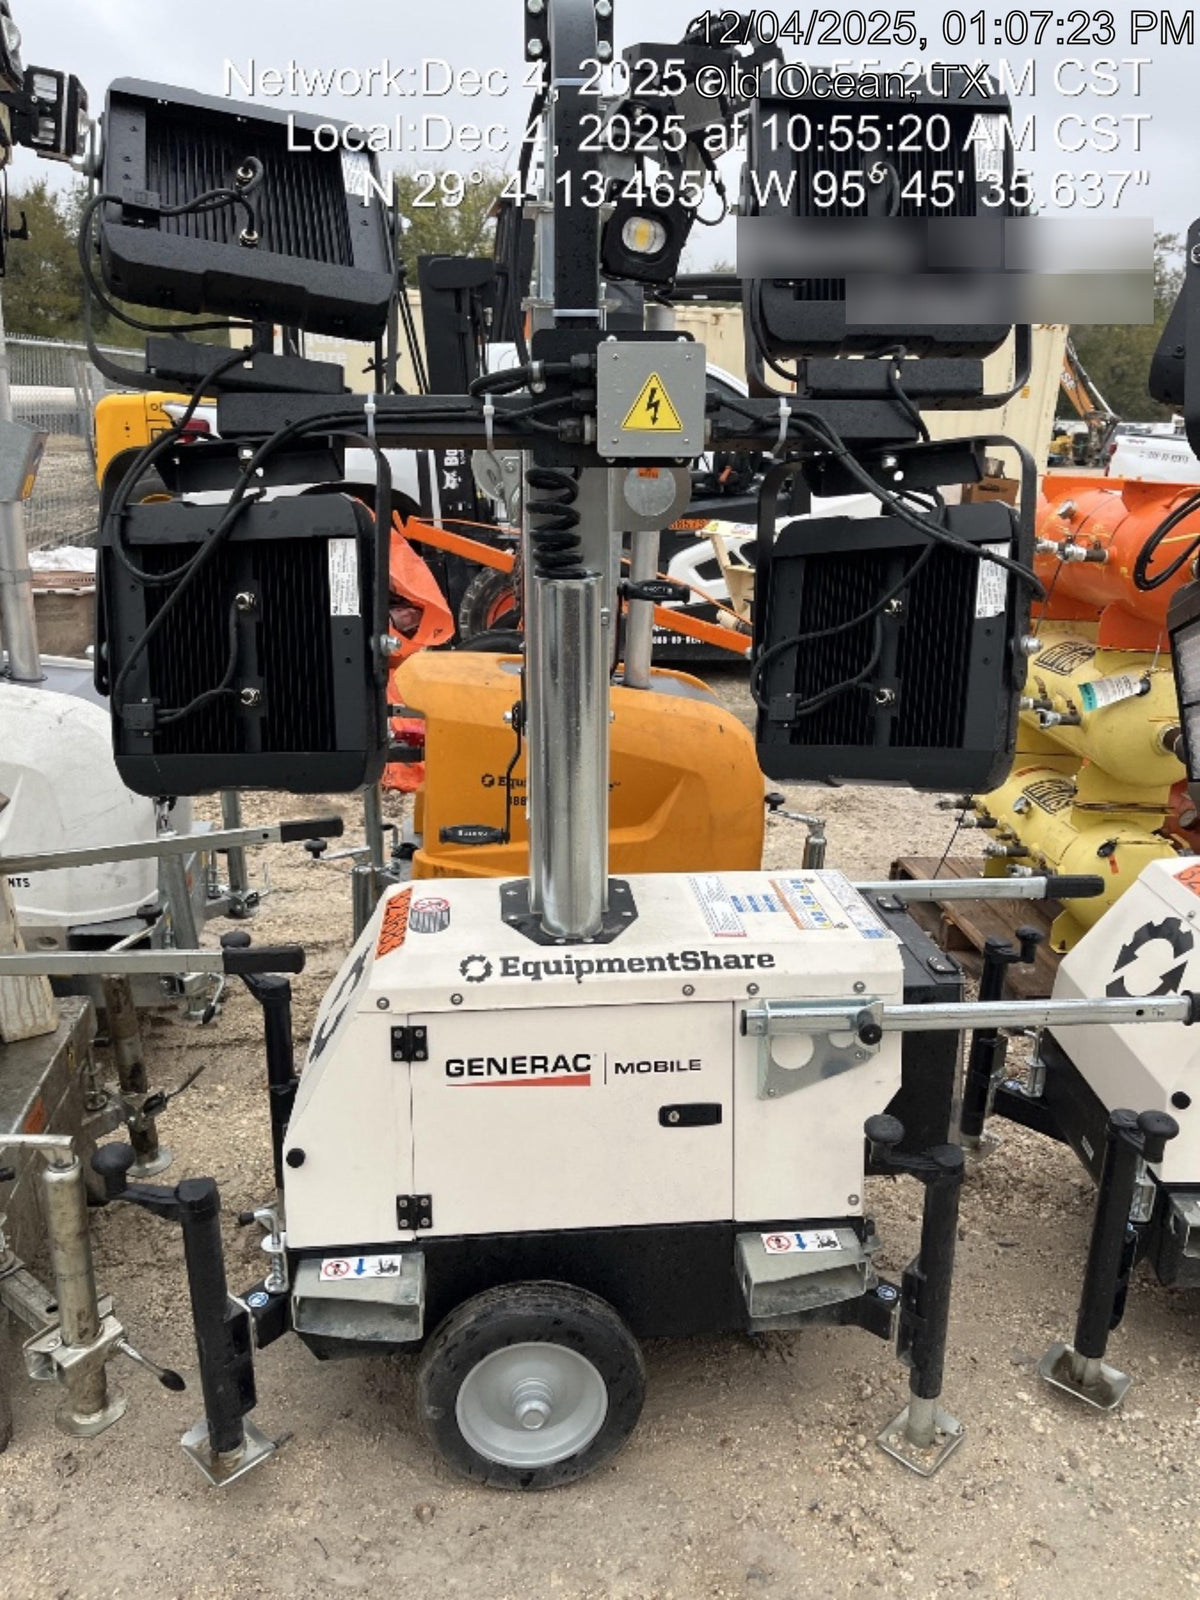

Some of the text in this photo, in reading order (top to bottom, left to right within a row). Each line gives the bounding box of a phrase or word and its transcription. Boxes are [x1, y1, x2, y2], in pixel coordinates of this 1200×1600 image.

[499, 950, 777, 983] EquipmentShare
[445, 1053, 703, 1078] GENERAC MOBILE
